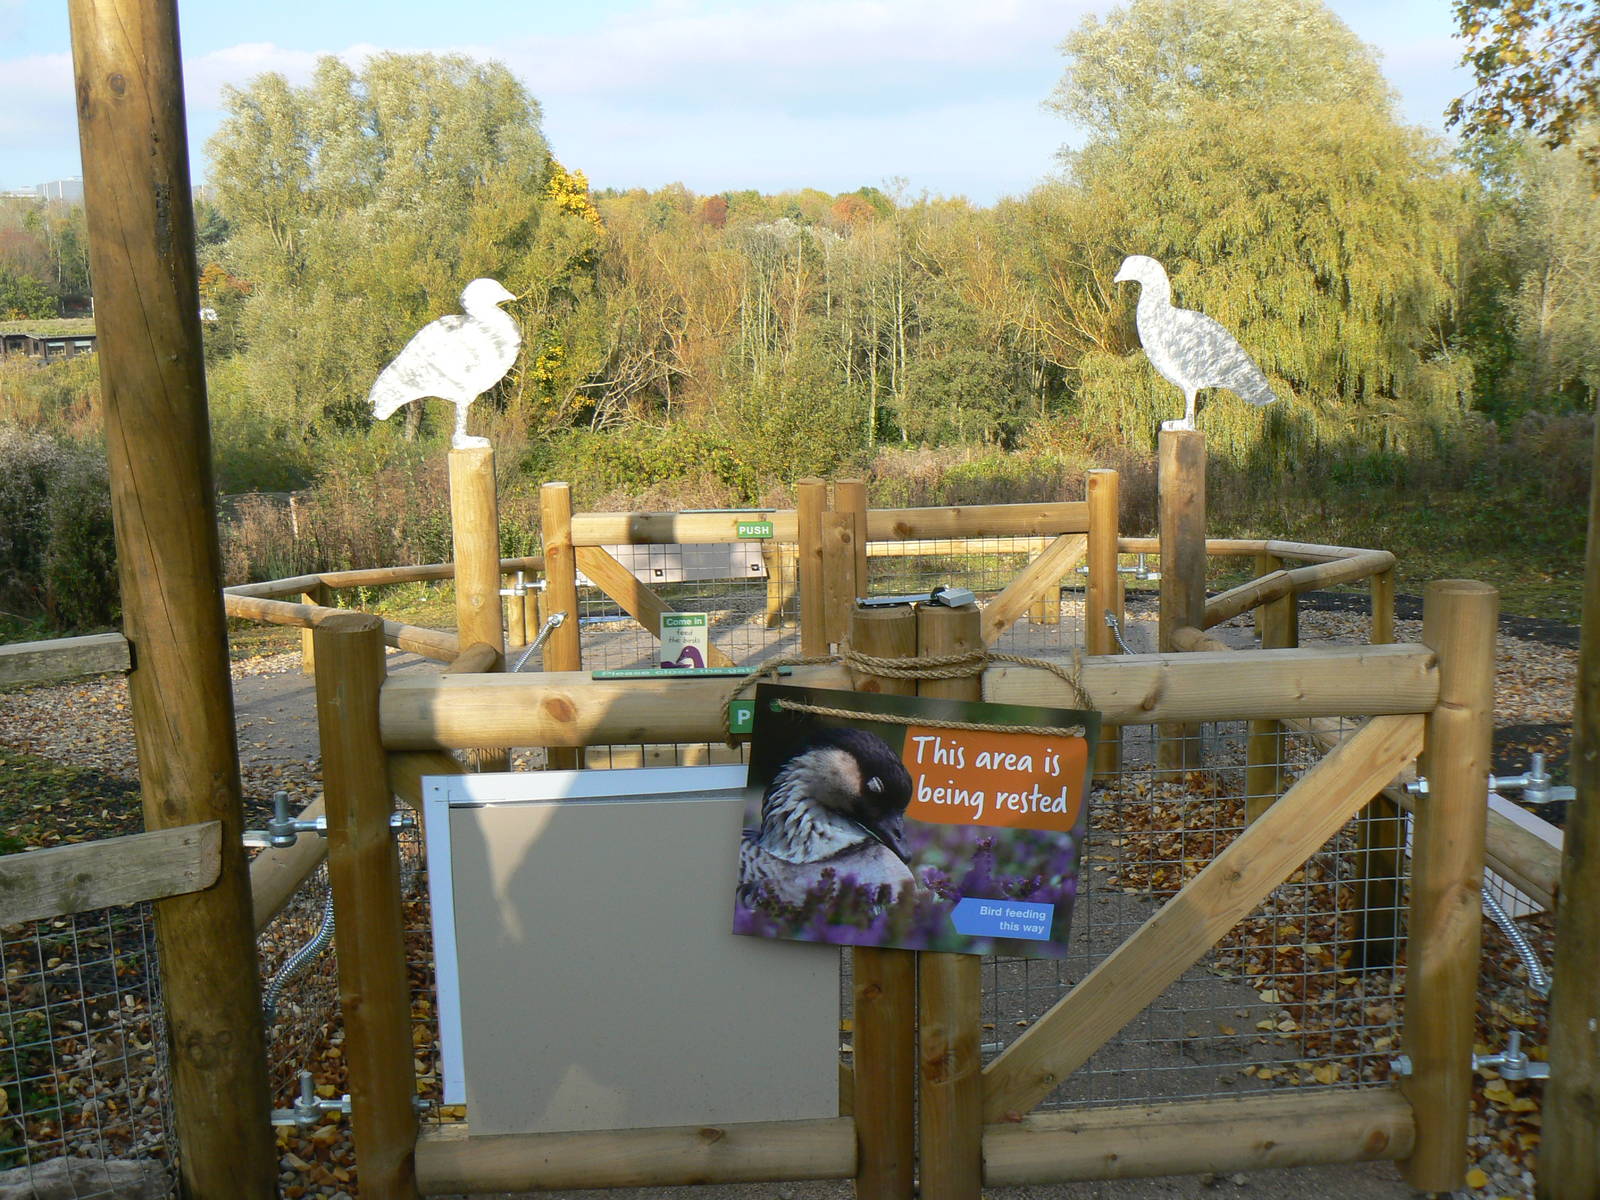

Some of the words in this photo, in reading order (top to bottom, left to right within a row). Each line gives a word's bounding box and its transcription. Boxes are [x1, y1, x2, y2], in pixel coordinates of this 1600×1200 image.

[739, 526, 769, 535] PUSH
[666, 617, 692, 626] Come
[912, 736, 965, 769] This
[975, 751, 1033, 773] area
[1044, 748, 1060, 777] is
[917, 774, 985, 820] being
[995, 783, 1068, 814] rested
[980, 906, 1003, 917] Bird
[1005, 908, 1047, 921] feeding
[1000, 921, 1020, 932] this
[1023, 924, 1045, 935] way
